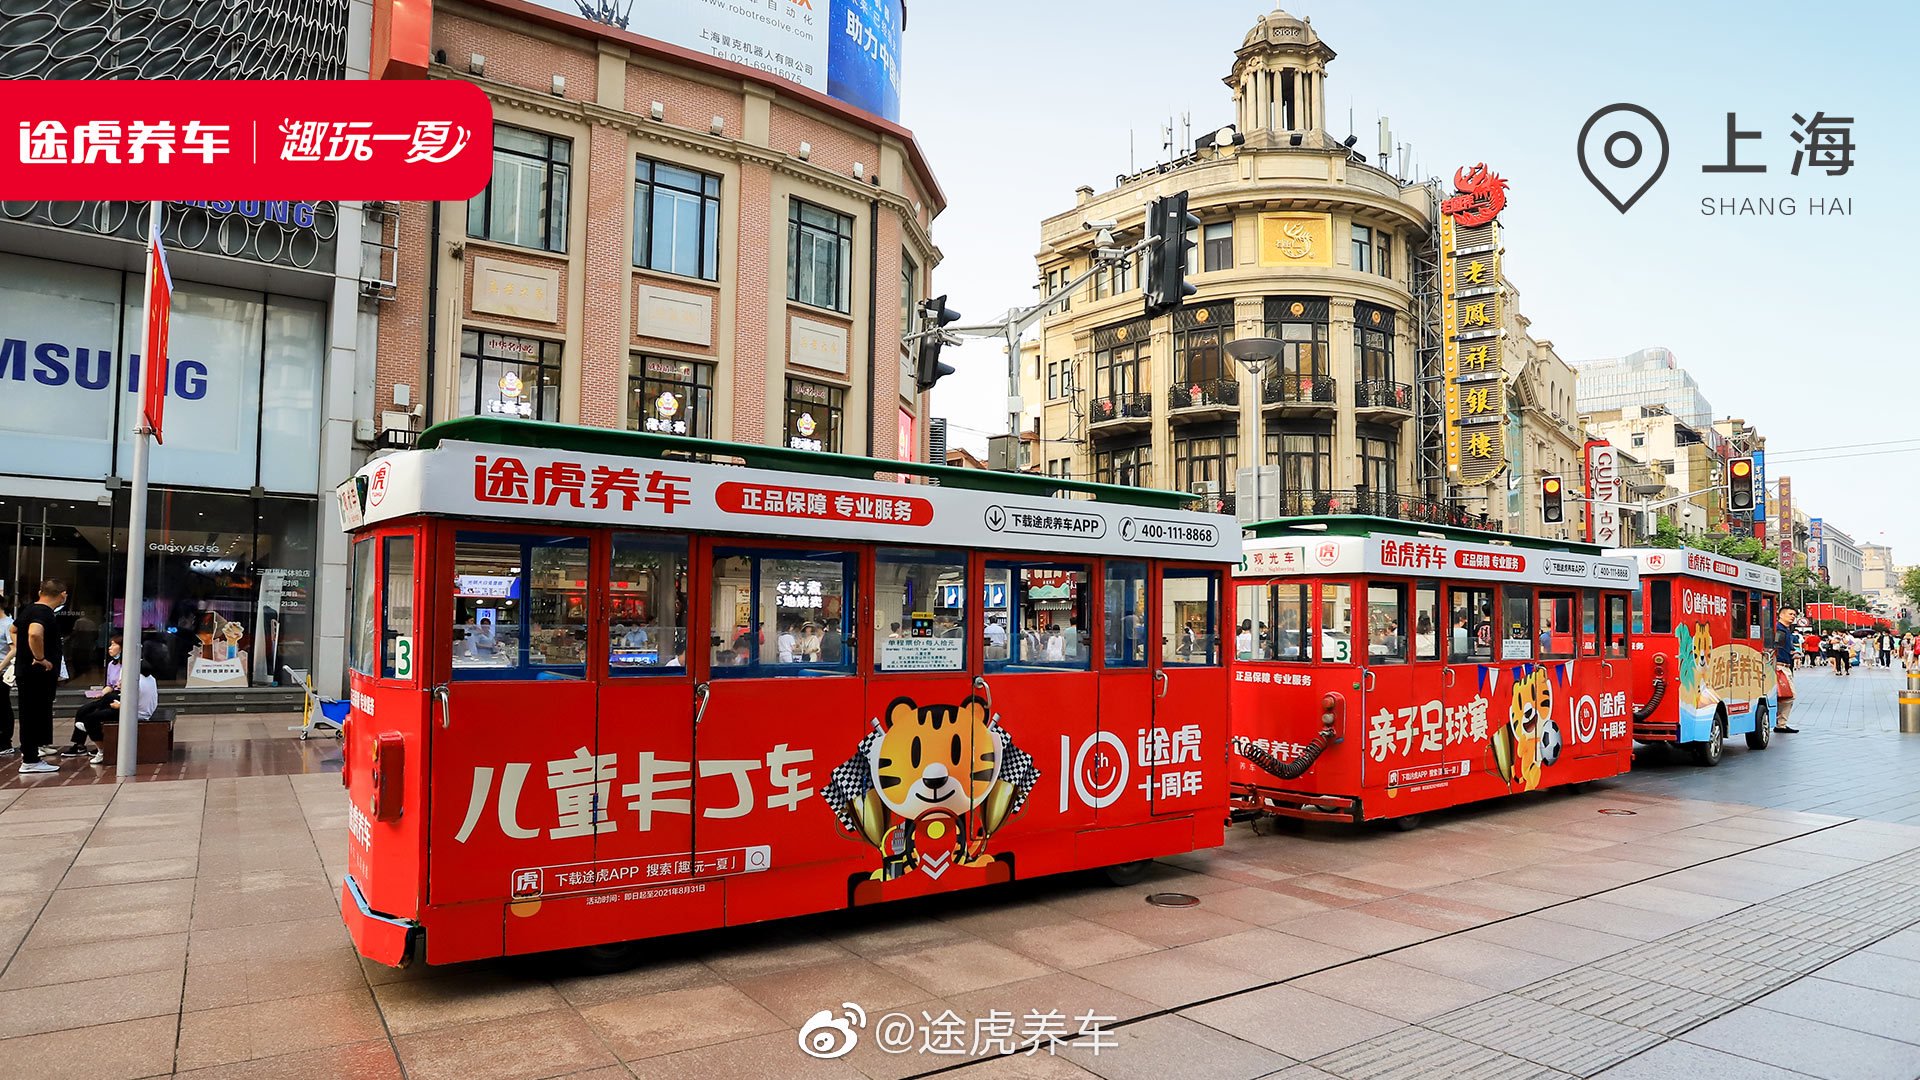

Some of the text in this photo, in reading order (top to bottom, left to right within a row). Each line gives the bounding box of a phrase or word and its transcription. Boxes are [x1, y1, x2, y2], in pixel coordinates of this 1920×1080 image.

[1463, 262, 1493, 459] 老鳳祥銀樓
[474, 455, 692, 514] 途虎养车
[741, 487, 913, 522] 正品保障 专业服务
[1011, 514, 1099, 533] 下载途虎养车APP
[1141, 523, 1213, 542] 400-111-8868
[149, 542, 220, 553] Galaxy A52 5G
[1254, 551, 1294, 565] 观光车
[1381, 540, 1447, 570] 途虎养车
[1462, 553, 1519, 571] 正品保障 专业服务
[1694, 592, 1727, 617] 途虎十周年
[397, 640, 411, 675] 3
[1336, 640, 1348, 661] 3
[1235, 670, 1312, 686] 正品保障 专业服务
[1600, 691, 1626, 718] 途虎
[1369, 693, 1489, 763] 亲子足球赛
[1569, 694, 1597, 745] 10
[1600, 720, 1627, 740] 十周年
[1138, 724, 1202, 767] 途虎
[1060, 730, 1130, 813] 10
[454, 743, 815, 845] 儿童卡丁车
[1138, 771, 1203, 801] 十周年
[516, 873, 539, 892] 虎
[554, 864, 640, 888] 下载途虎APP
